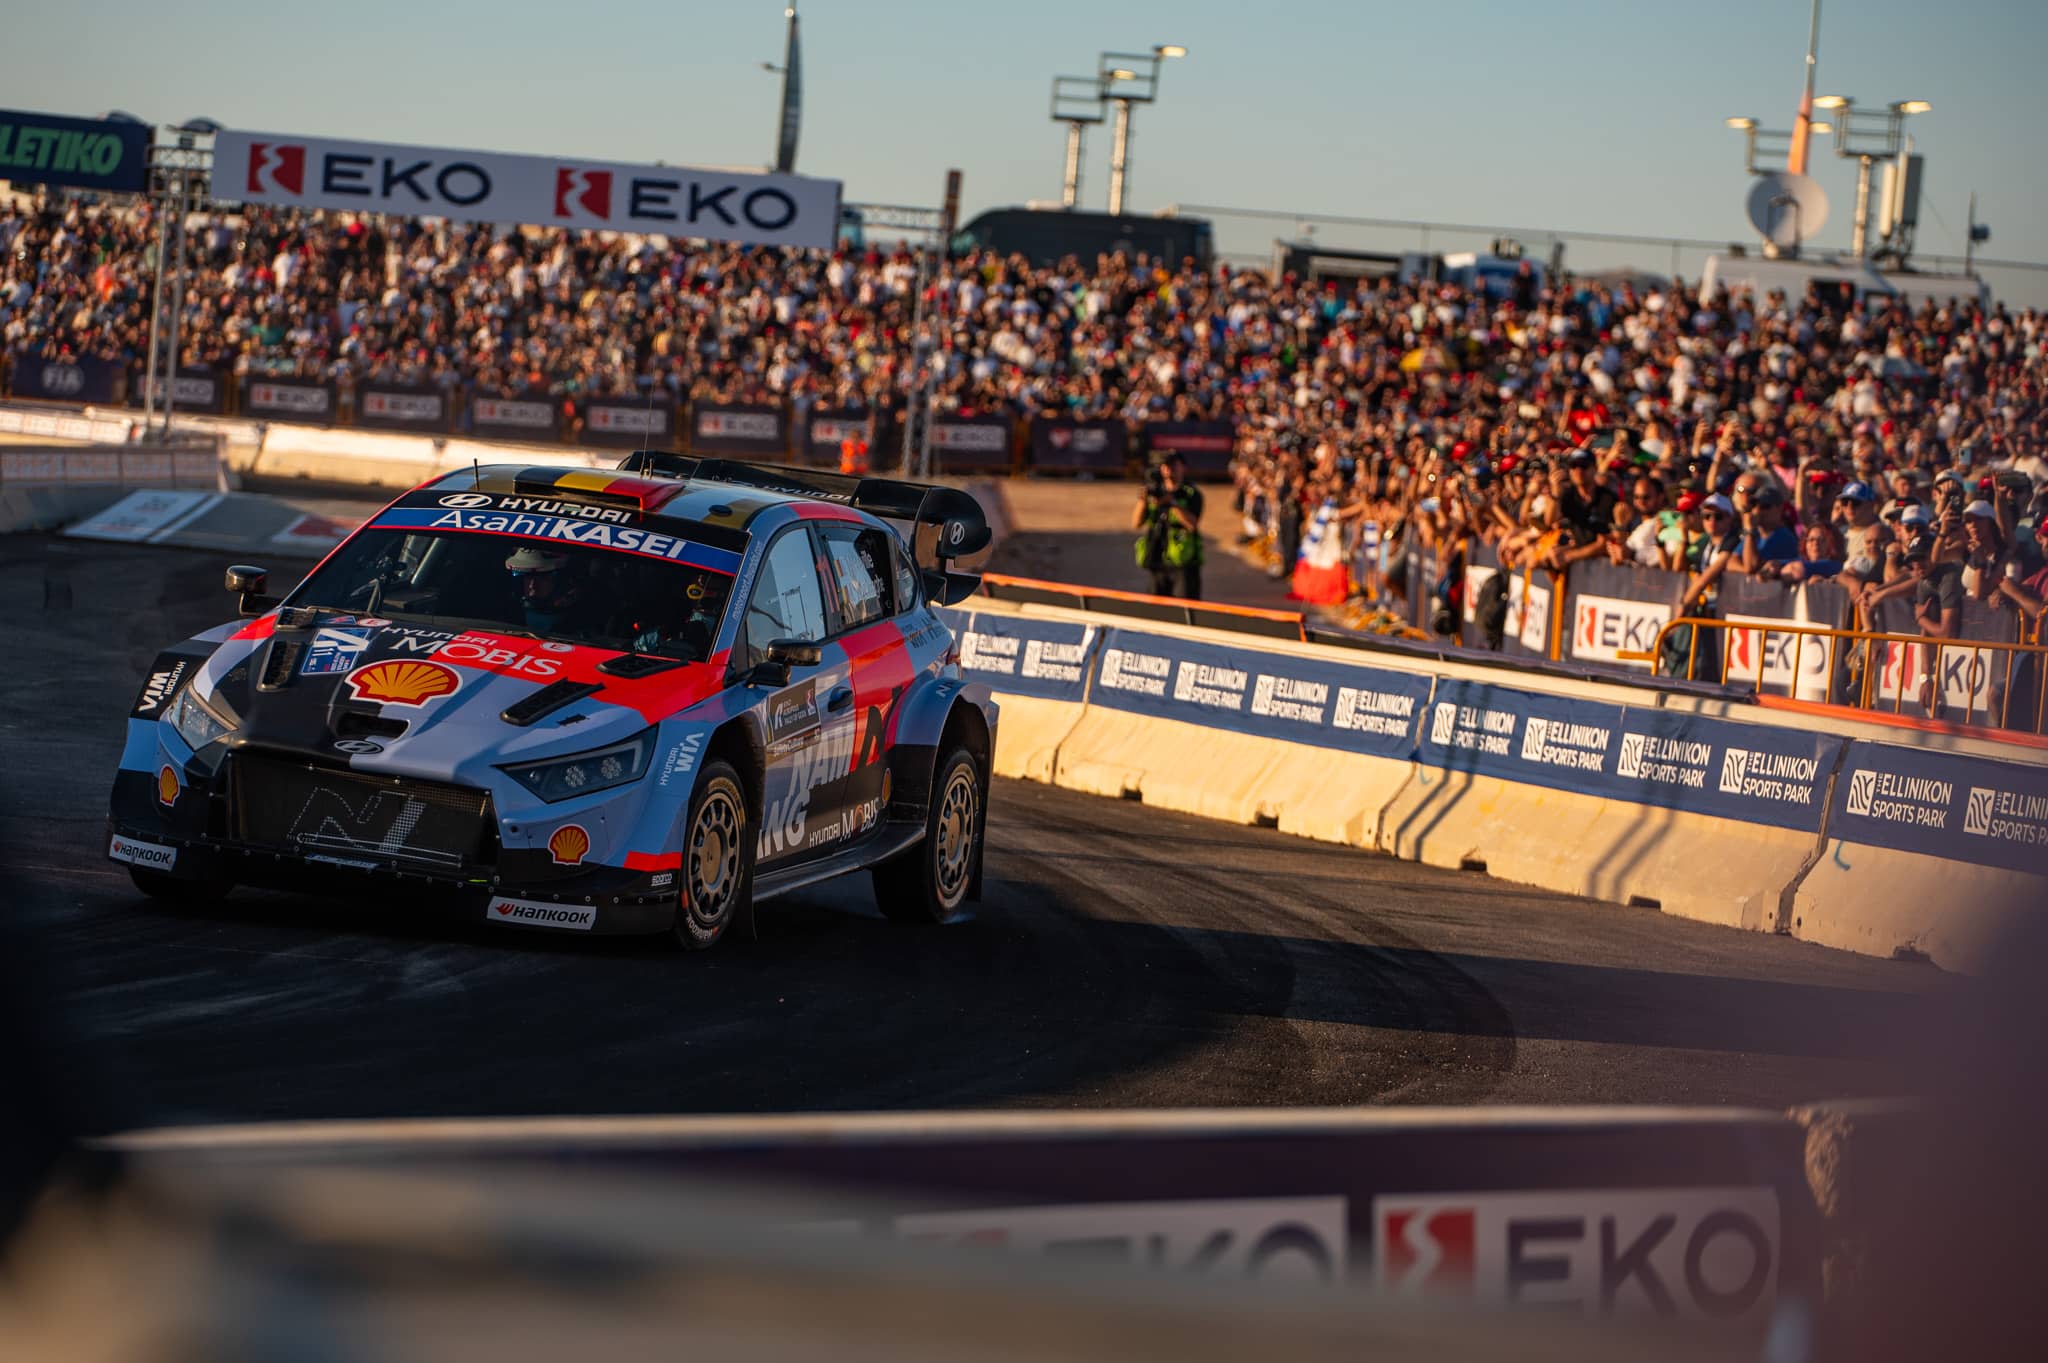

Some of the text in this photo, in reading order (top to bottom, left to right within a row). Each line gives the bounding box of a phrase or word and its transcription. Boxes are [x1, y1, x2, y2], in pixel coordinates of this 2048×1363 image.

[321, 152, 492, 206] EKO
[629, 178, 797, 230] EKO
[43, 367, 80, 390] FIA
[500, 497, 632, 524] HYUNDAI
[382, 626, 498, 646] HYUNDAI
[1602, 612, 1663, 652] EKO
[389, 636, 563, 675] MOBIS
[163, 660, 187, 695] HYUNDAI
[1277, 678, 1329, 704] ELLINIKON
[1270, 700, 1324, 724] SPORTS PARK
[1360, 690, 1415, 717] ELLINIKON
[1352, 713, 1409, 737] SPORTS PARK
[1459, 705, 1516, 735] ELLINIKON
[1485, 737, 1511, 756] PARK
[1550, 720, 1610, 750] ELLINIKON
[1542, 745, 1604, 772] SPORTS PARK
[1648, 736, 1713, 767] ELLINIKON
[659, 747, 678, 786] HYUNDAI
[1639, 761, 1706, 789] SPORTS PARK
[1750, 751, 1819, 782] ELLINIKON
[1742, 777, 1813, 805] SPORTS PARK
[1881, 773, 1953, 806] ELLINIKON
[1871, 800, 1948, 829] SPORTS PARK
[809, 821, 841, 848] HYUNDAI
[1990, 818, 2038, 844] SPORTS
[1508, 1210, 1772, 1316] EKO
